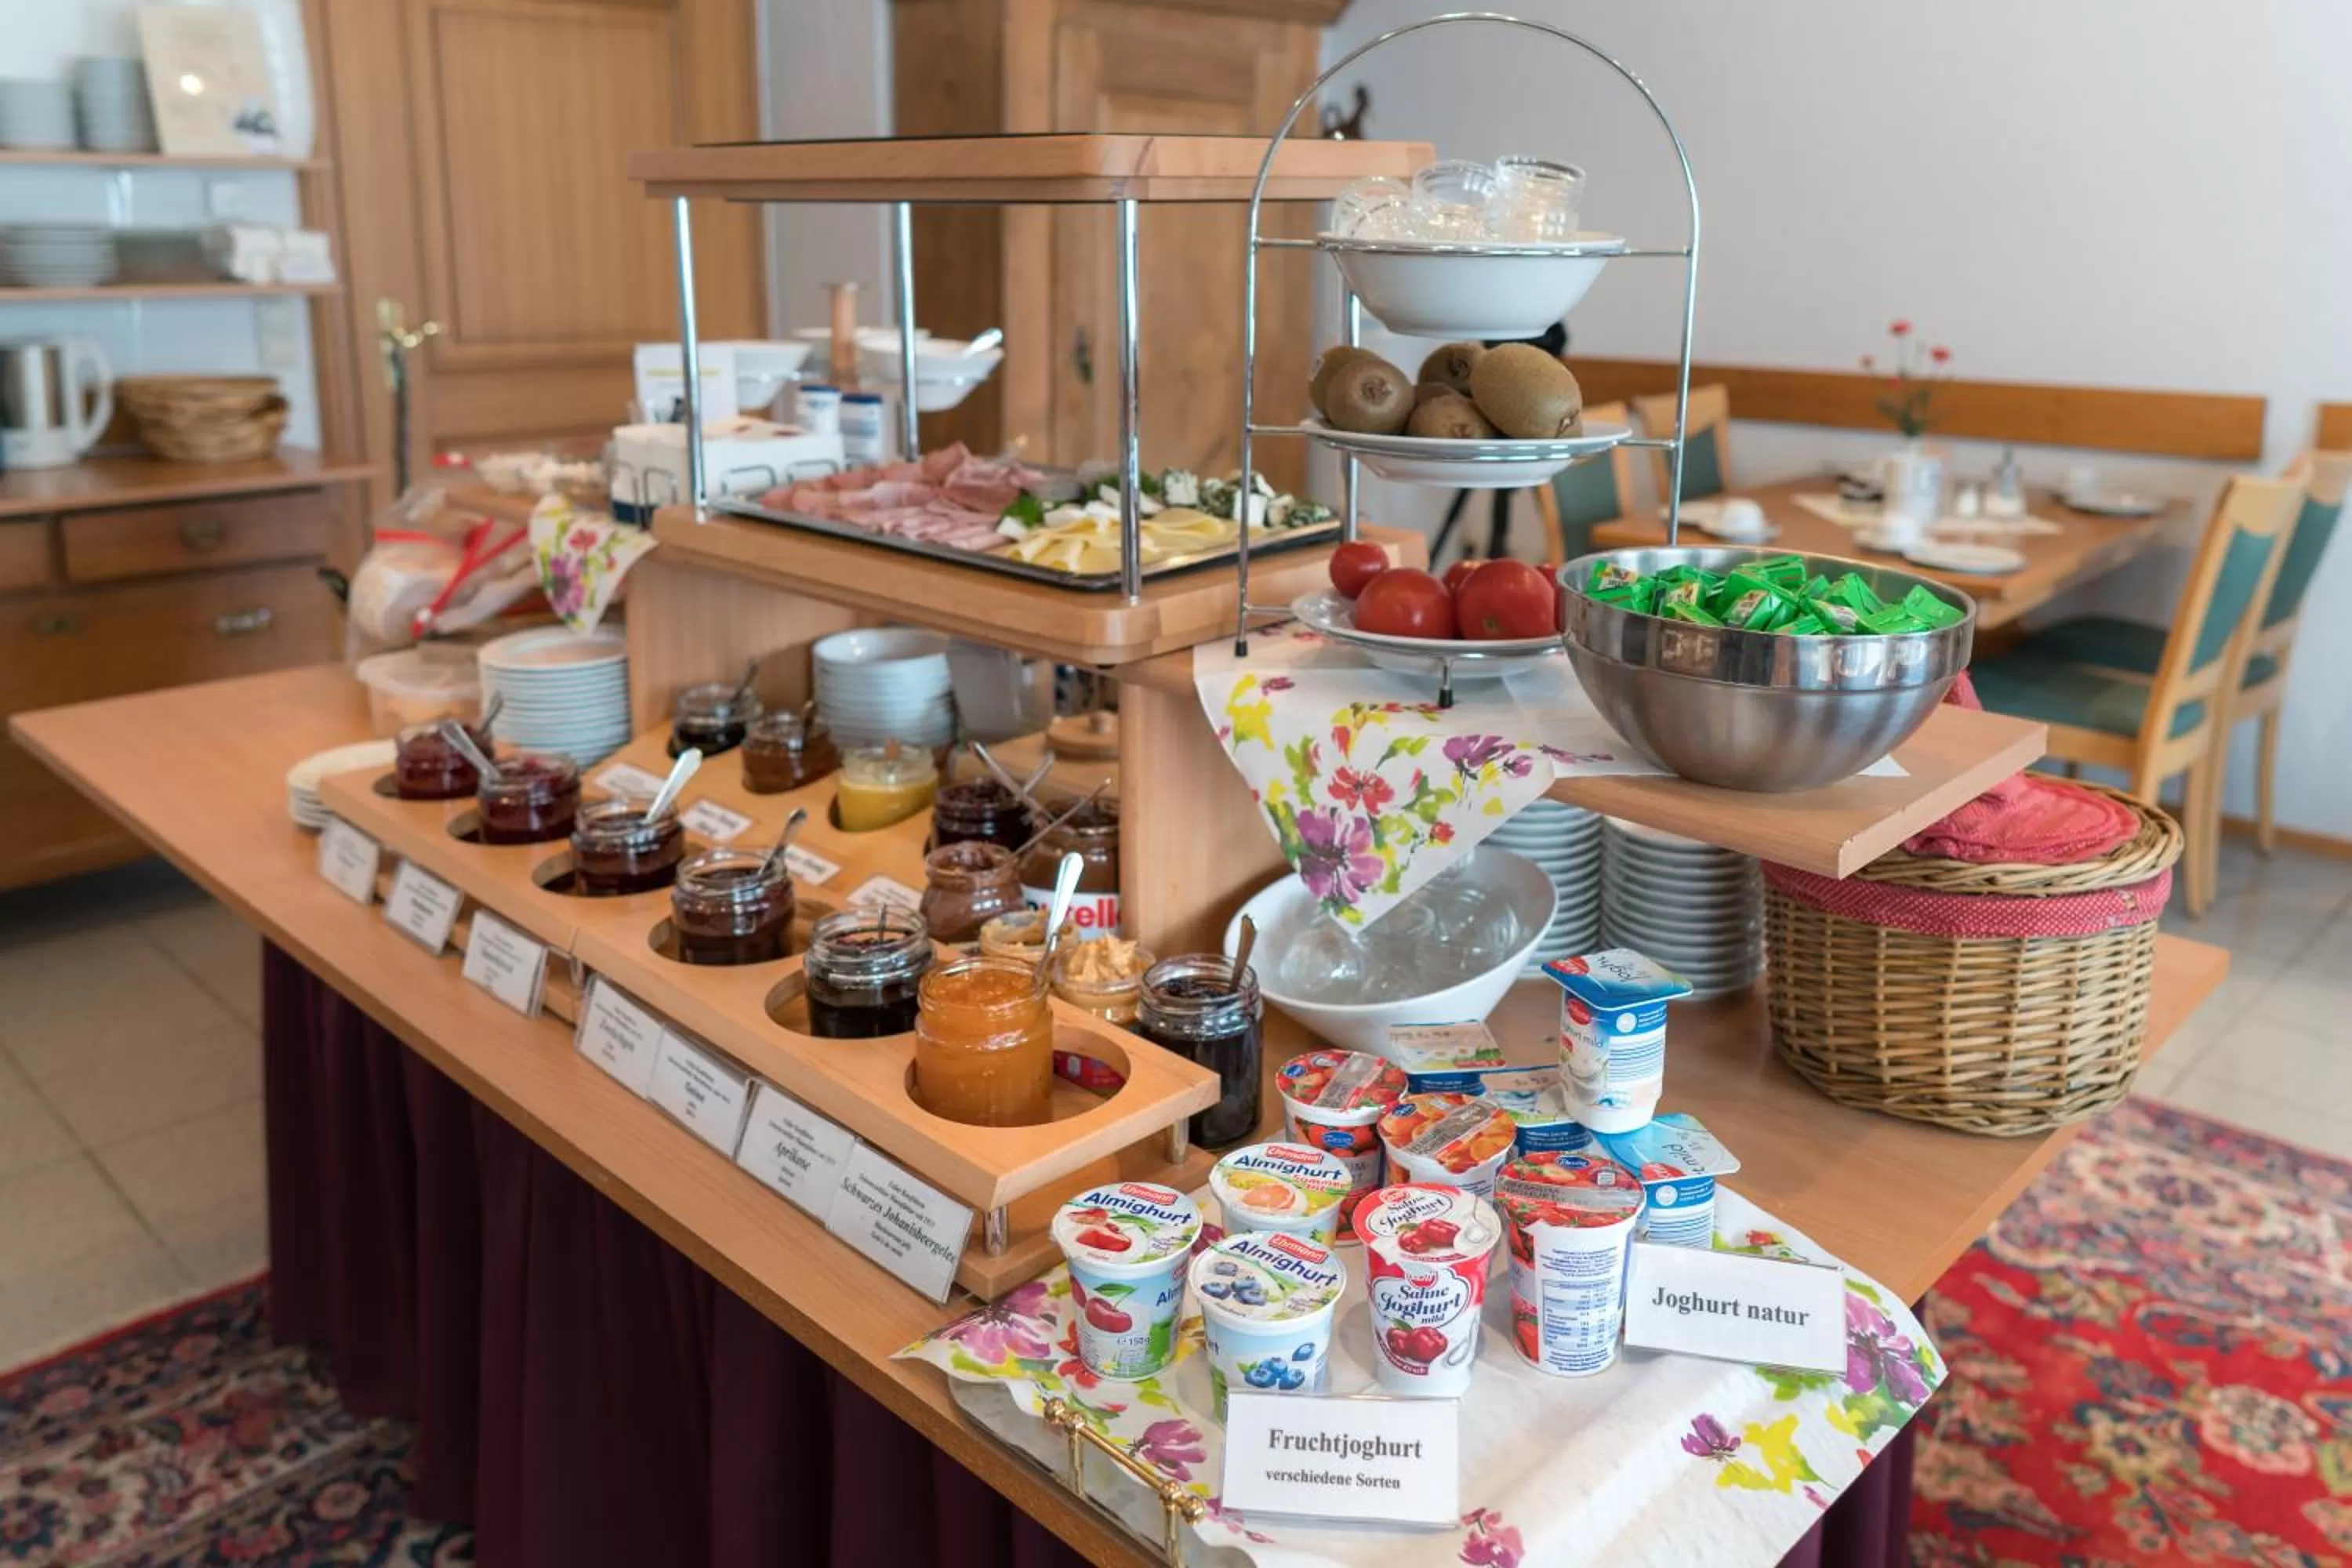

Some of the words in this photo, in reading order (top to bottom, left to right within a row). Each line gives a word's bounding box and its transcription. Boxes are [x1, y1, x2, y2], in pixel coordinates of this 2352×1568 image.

[1233, 1154, 1343, 1180] Almighurt
[1083, 1192, 1192, 1225] Almighurt
[1229, 1239, 1339, 1287] Almighurt
[1380, 1292, 1461, 1320] Joghurt
[1399, 1284, 1450, 1300] Sahne
[1421, 1313, 1446, 1324] mild
[1651, 1286, 1741, 1317] Joghurt
[1747, 1302, 1811, 1327] natur
[1268, 1428, 1422, 1461] Fruchtjoghurt
[1265, 1468, 1352, 1486] verschiedene
[1355, 1472, 1402, 1490] Sorten
